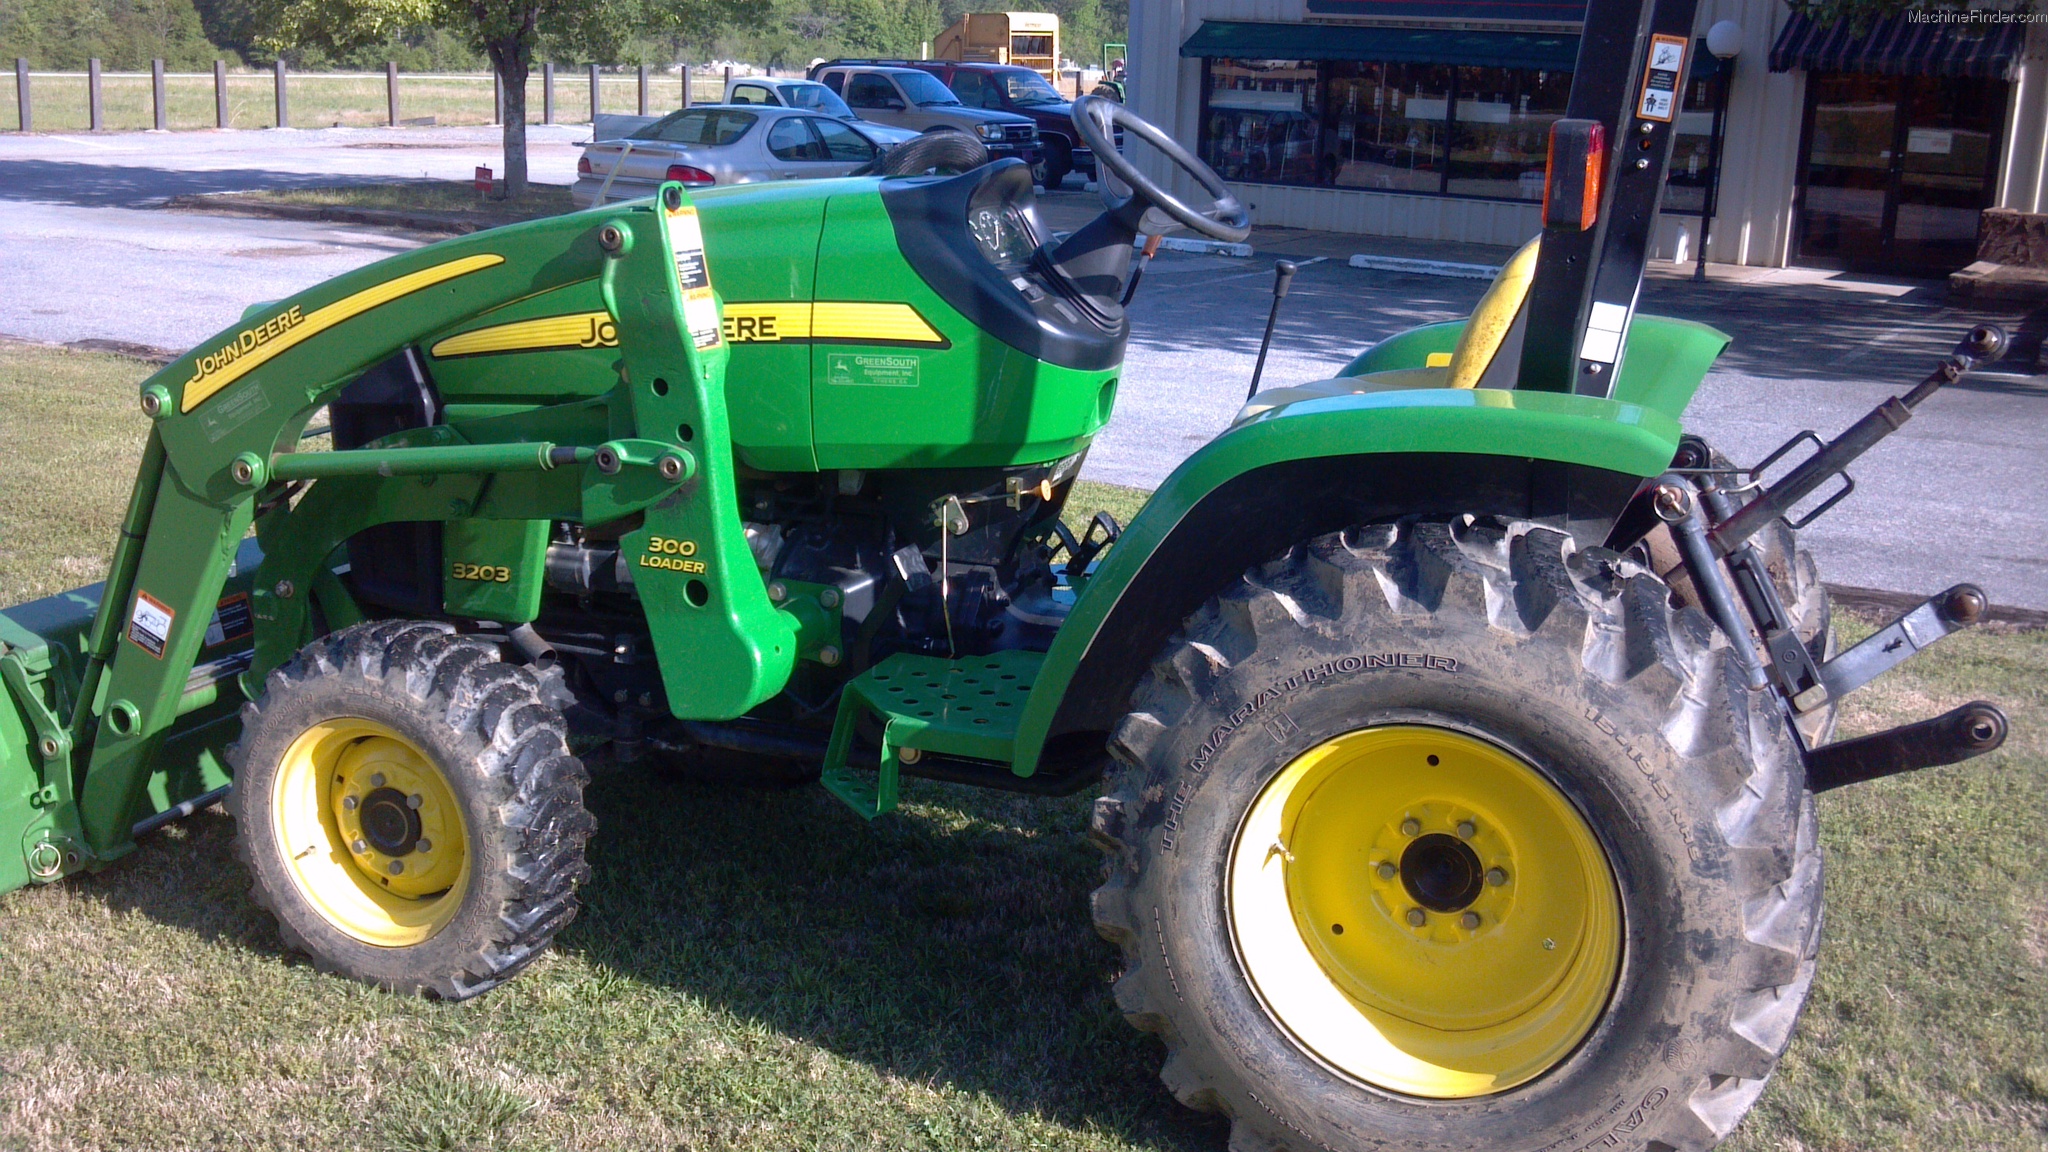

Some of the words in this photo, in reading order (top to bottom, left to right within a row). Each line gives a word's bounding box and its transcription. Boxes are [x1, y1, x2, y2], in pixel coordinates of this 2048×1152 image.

[580, 317, 619, 345] JO
[724, 316, 777, 338] ERE
[192, 340, 241, 383] JOHN
[238, 304, 305, 356] DEERE
[648, 536, 697, 557] 300
[453, 562, 511, 582] 3203
[640, 554, 706, 574] LOADER
[1161, 780, 1192, 855] THE
[1190, 652, 1459, 774] MARATHONER
